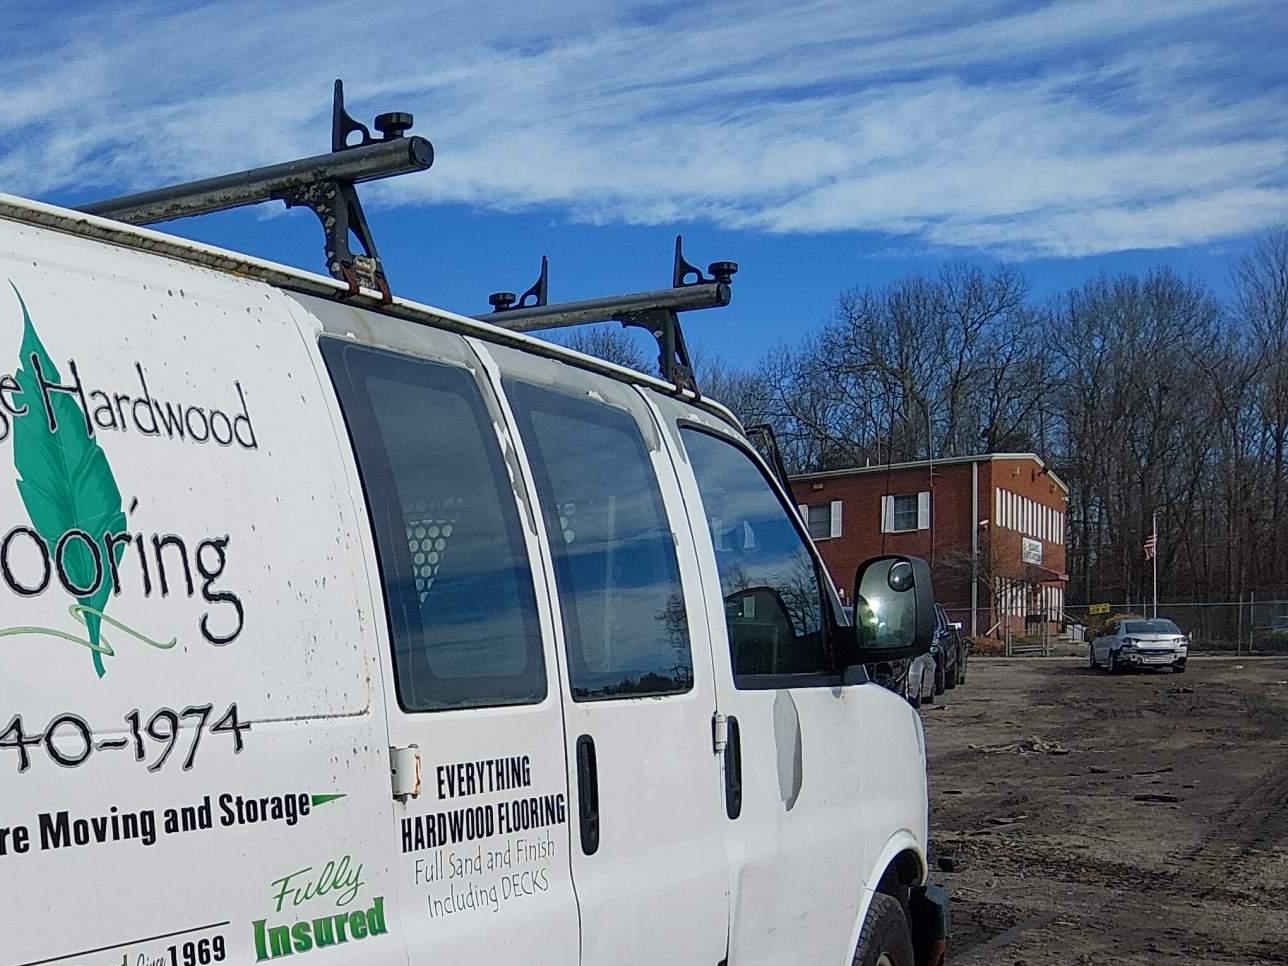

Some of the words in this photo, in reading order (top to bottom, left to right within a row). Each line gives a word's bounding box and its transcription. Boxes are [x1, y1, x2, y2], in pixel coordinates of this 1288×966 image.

[31, 353, 259, 449] Hardwood
[436, 755, 531, 800] EVERYTHING
[38, 807, 156, 852] Moving
[163, 792, 213, 834] and
[219, 790, 311, 827] Storage
[401, 805, 495, 853] HARDWOOD
[498, 793, 566, 835] FLOORING
[271, 855, 365, 912] Fully
[415, 850, 443, 885] Full
[448, 845, 482, 879] Sand
[487, 840, 511, 871] and
[516, 830, 555, 864] Finish
[428, 882, 499, 918] Including
[501, 868, 549, 900] DECKS
[252, 897, 390, 962] Insured
